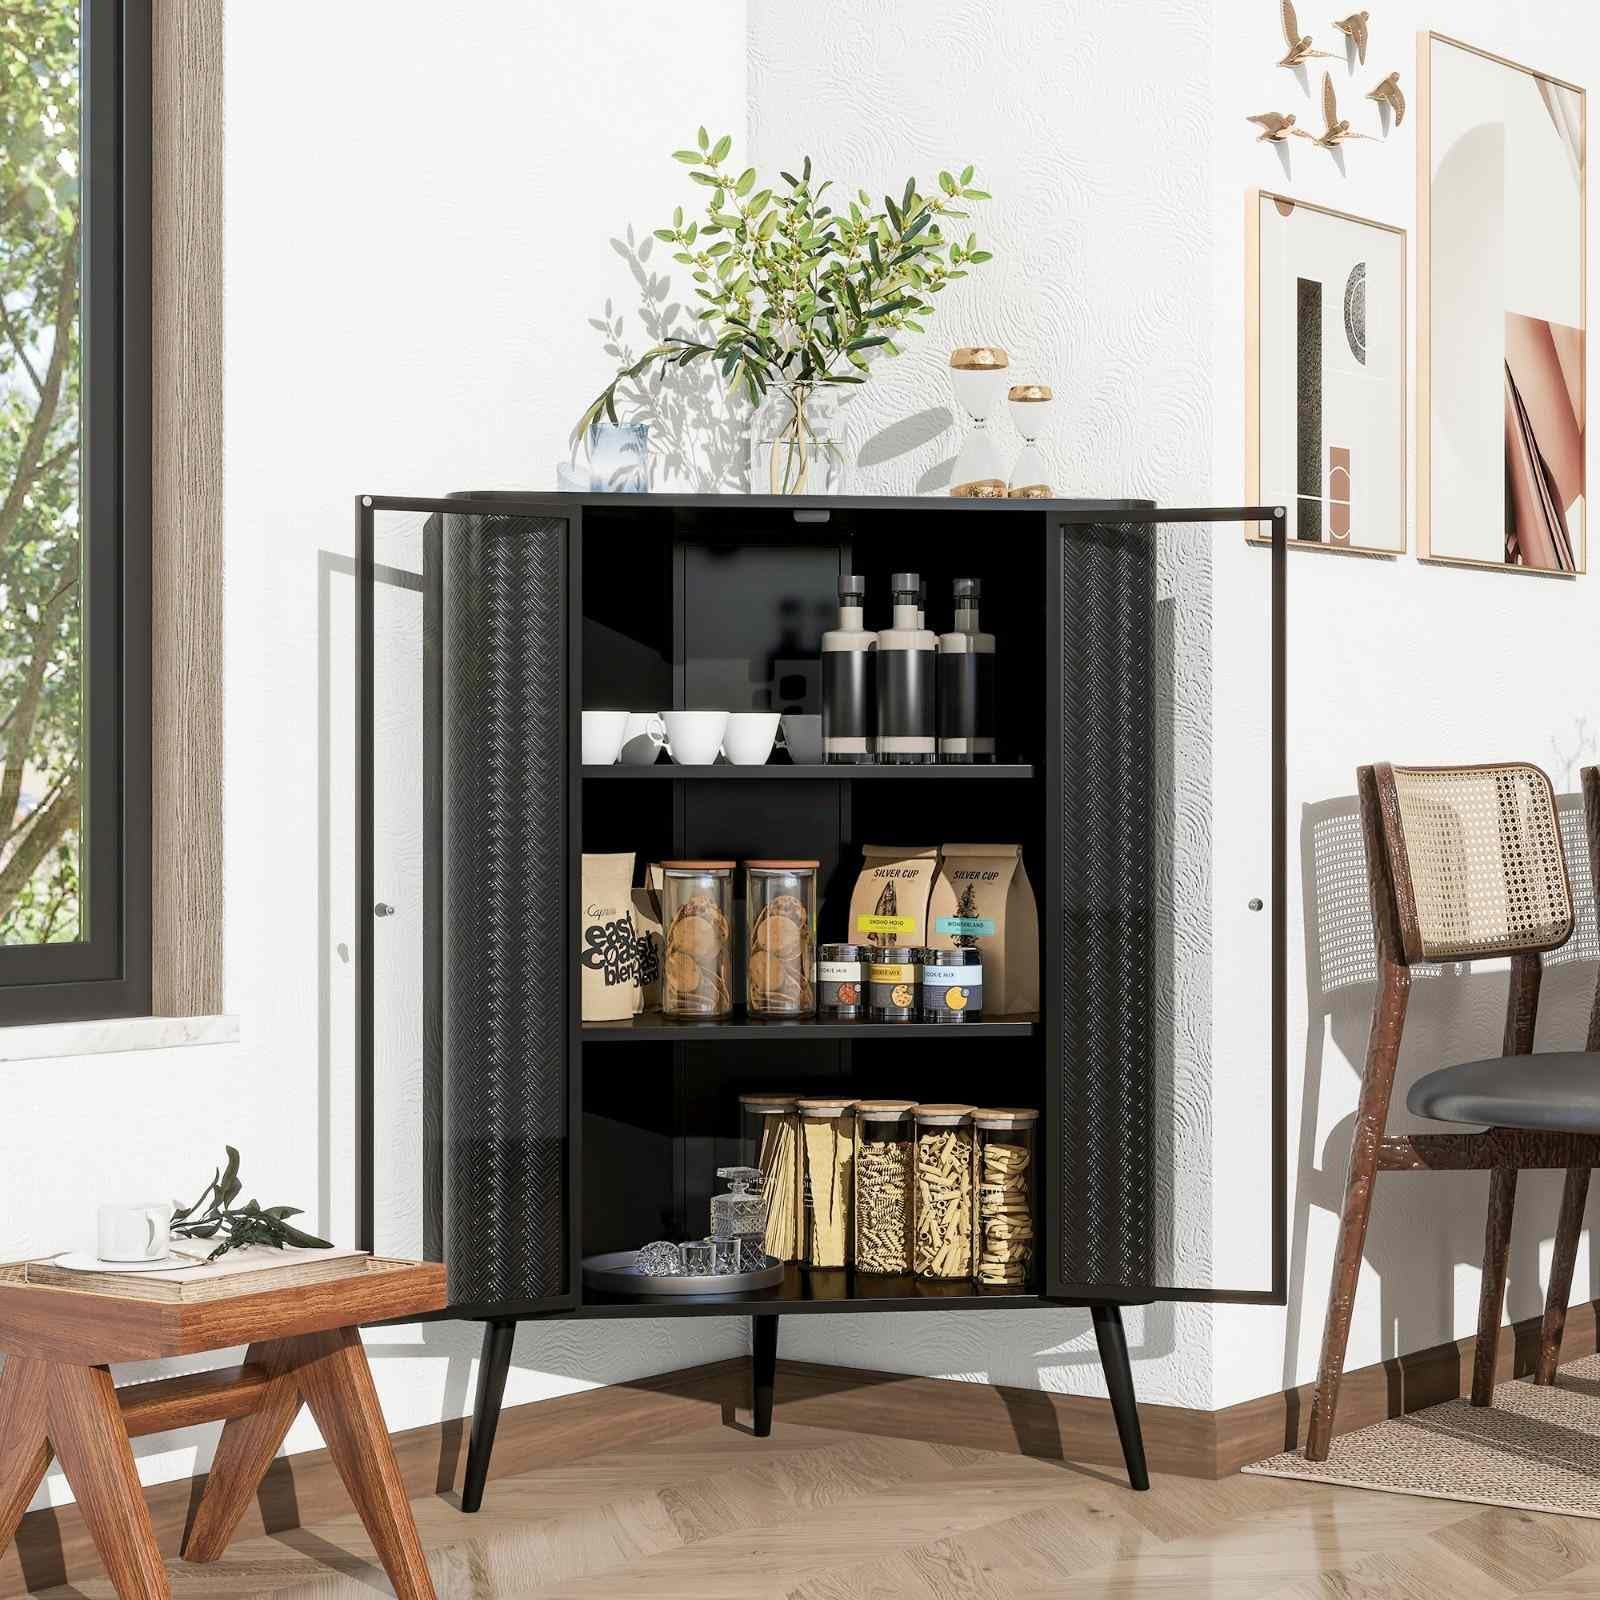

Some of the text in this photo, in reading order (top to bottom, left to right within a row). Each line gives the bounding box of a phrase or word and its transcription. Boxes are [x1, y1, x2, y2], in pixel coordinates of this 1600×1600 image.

[873, 868, 920, 879] SILVER CUP
[953, 870, 1000, 880] SILVER CUP
[585, 909, 636, 946] east
[581, 937, 640, 970] coas
[604, 956, 635, 987] blen
